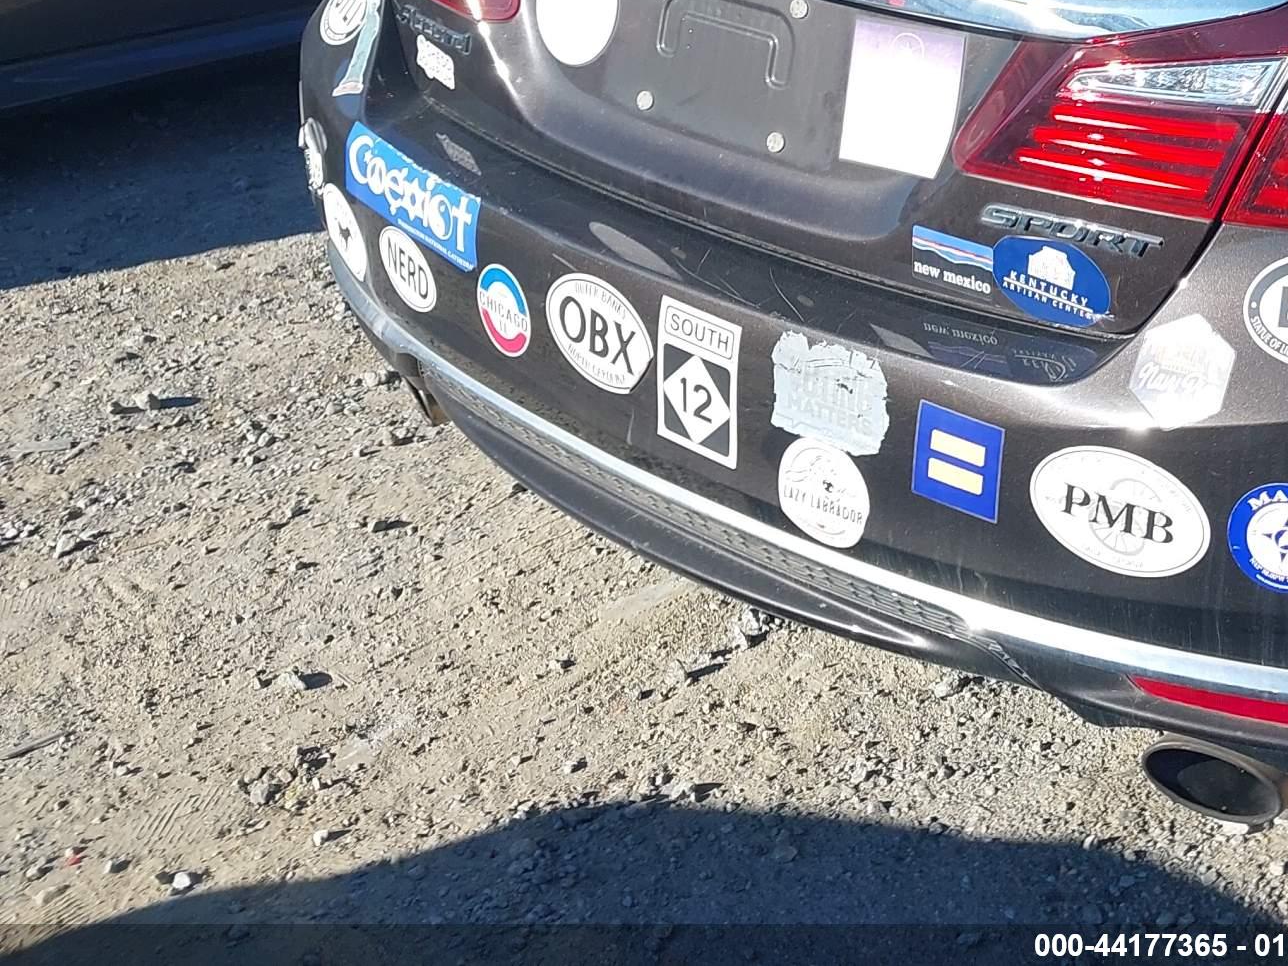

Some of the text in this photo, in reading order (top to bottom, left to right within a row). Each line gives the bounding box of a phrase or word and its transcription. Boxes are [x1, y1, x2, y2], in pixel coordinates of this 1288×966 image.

[396, 3, 473, 56] Accord
[980, 203, 1165, 258] SPORT
[387, 236, 429, 300] NERD
[913, 260, 992, 295] new mexico
[1009, 269, 1089, 307] KENTUCKY
[479, 291, 528, 332] CHICAGO
[1002, 280, 1048, 305] ARTISAN
[559, 295, 636, 376] OBX
[670, 312, 730, 353] SOUTH
[1250, 315, 1271, 341] STATUE
[1269, 338, 1281, 351] OF
[680, 377, 712, 424] 12
[783, 484, 863, 525] LAZY LABRADOR
[1061, 482, 1174, 544] PMB
